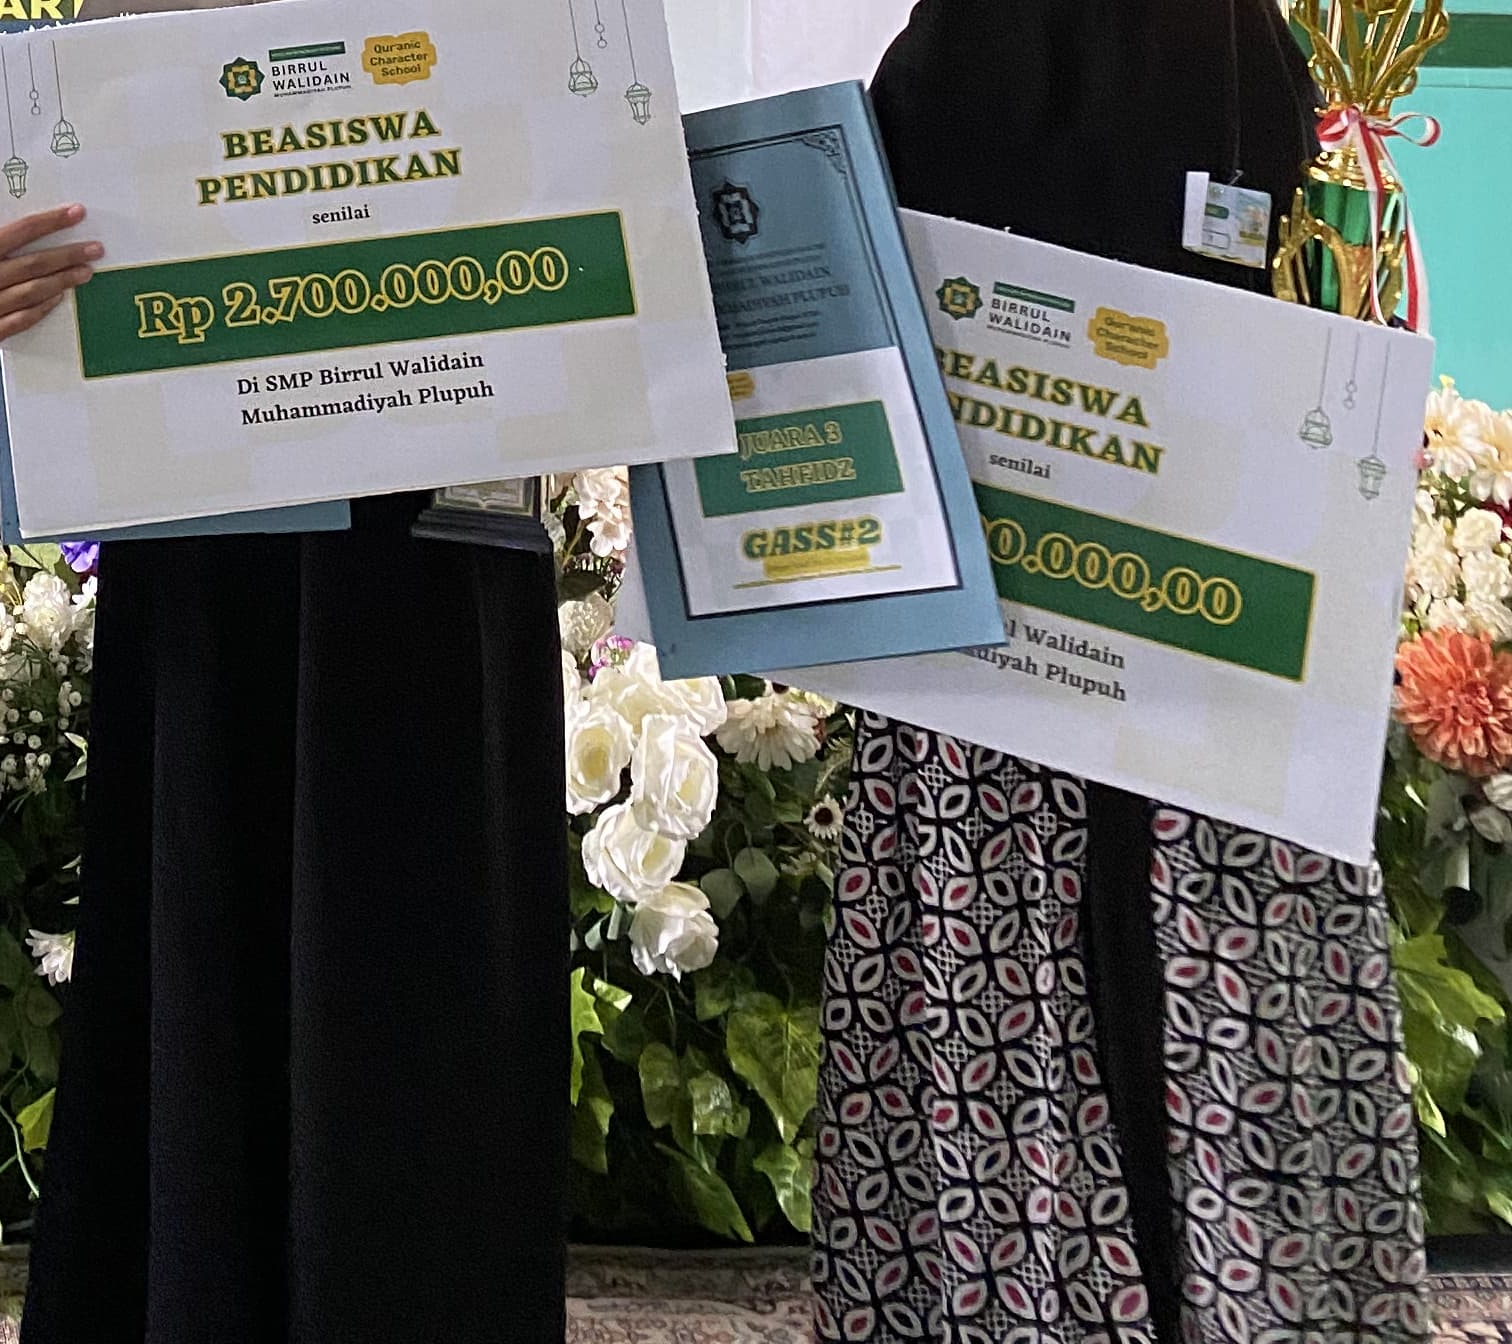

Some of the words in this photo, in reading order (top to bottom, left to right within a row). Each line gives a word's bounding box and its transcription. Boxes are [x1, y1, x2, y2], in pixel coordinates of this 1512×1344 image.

[271, 61, 328, 77] BIRRUL
[369, 52, 428, 66] Character
[381, 64, 421, 77] School
[272, 72, 350, 91] WALIDAIN
[222, 109, 441, 160] BEASISWA
[197, 148, 463, 206] PENDIDIKAN
[312, 204, 371, 225] senilai
[134, 291, 215, 344] Rp
[223, 247, 569, 328] 2.700.000,00
[990, 297, 1051, 323] BIRRUL
[988, 312, 1072, 343] WALIDAIN
[237, 377, 260, 396] Di
[266, 370, 314, 392] SMP
[319, 362, 384, 387] Birrul
[388, 352, 484, 377] Walidain
[241, 392, 412, 426] Muhammadiyah
[419, 380, 495, 408] Plupuh
[740, 423, 824, 461] JUARA
[824, 420, 843, 445] 3
[989, 452, 1052, 479] senilai
[743, 517, 881, 559] GASS#2
[982, 515, 1243, 625] 0.000,00
[1023, 624, 1126, 670] Walidain
[1045, 663, 1127, 702] Plupuh
